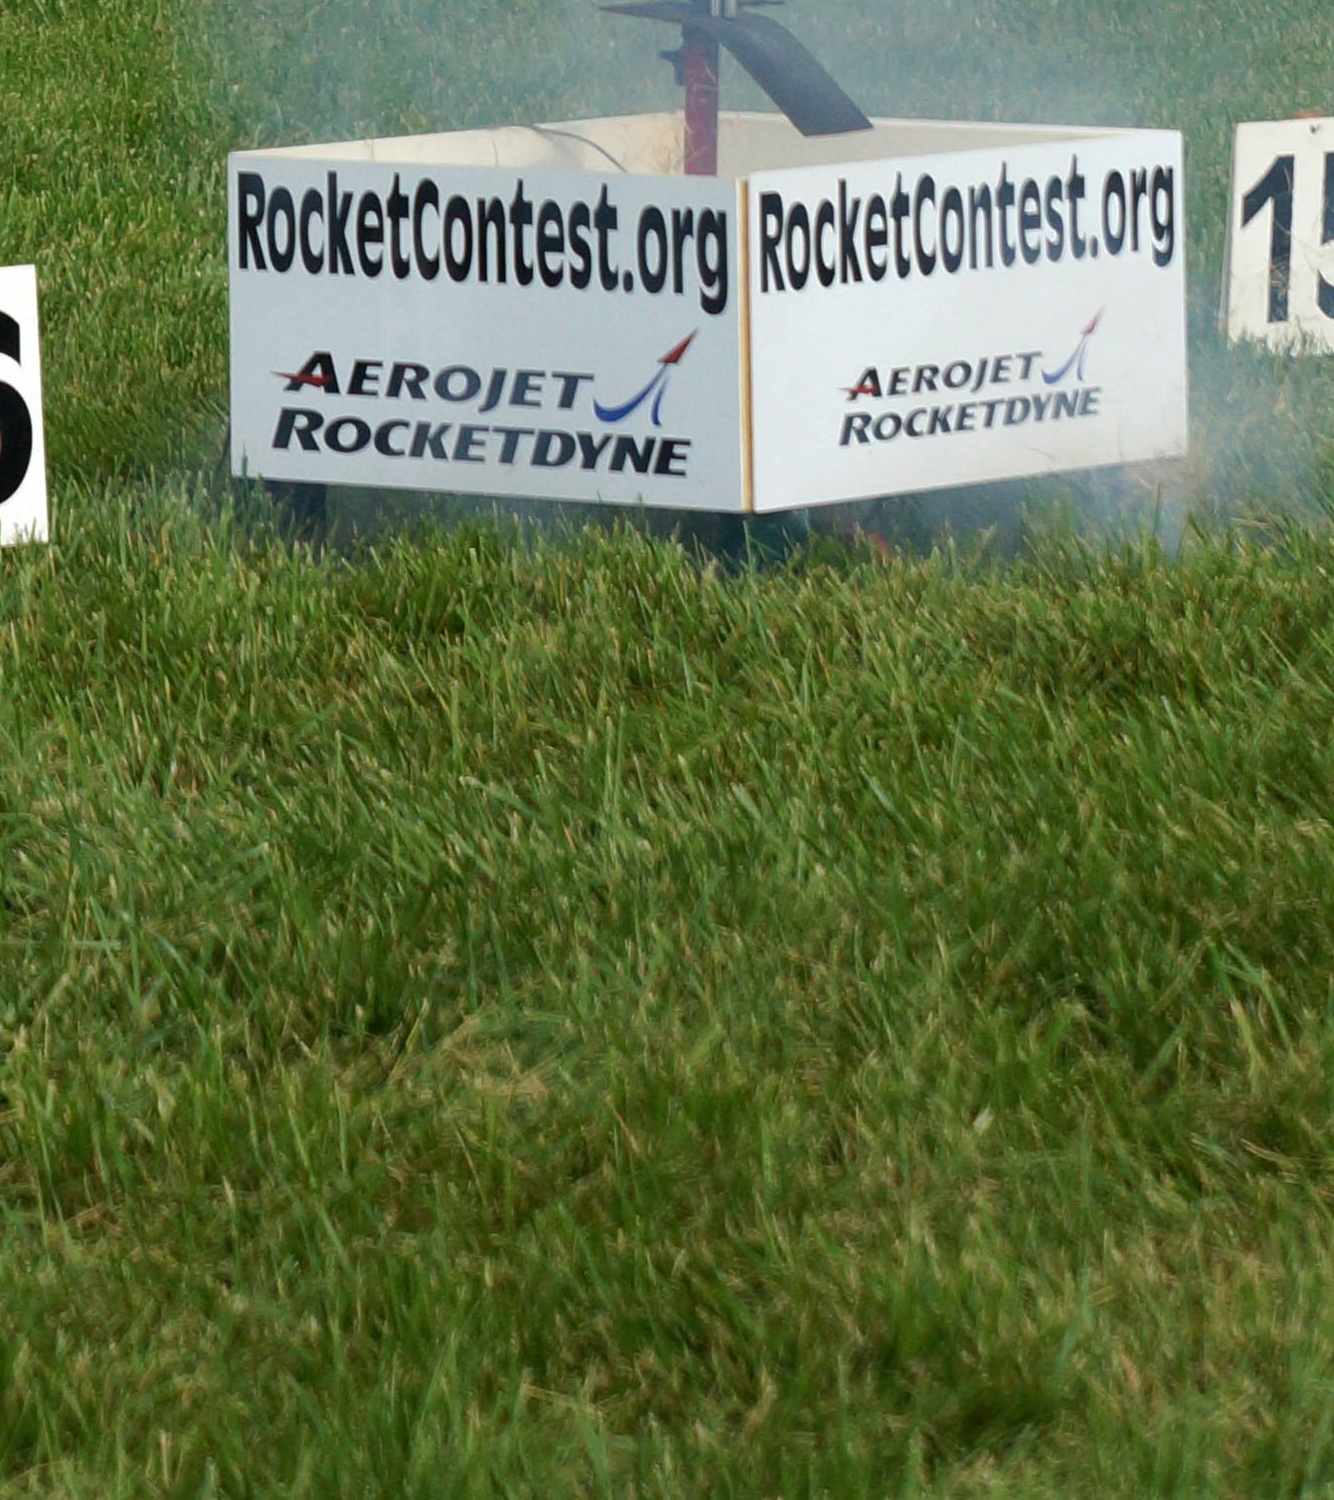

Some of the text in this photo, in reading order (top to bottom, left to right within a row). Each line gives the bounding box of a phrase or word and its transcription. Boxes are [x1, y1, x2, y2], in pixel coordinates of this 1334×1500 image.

[237, 170, 729, 316] RocketContest.org
[759, 154, 1175, 295] RocketContest.org
[279, 350, 595, 414] AEROJET
[845, 350, 1043, 401] AEROJET
[272, 407, 692, 477] ROCKETDYNE
[839, 386, 1102, 447] ROCKETDYNE
